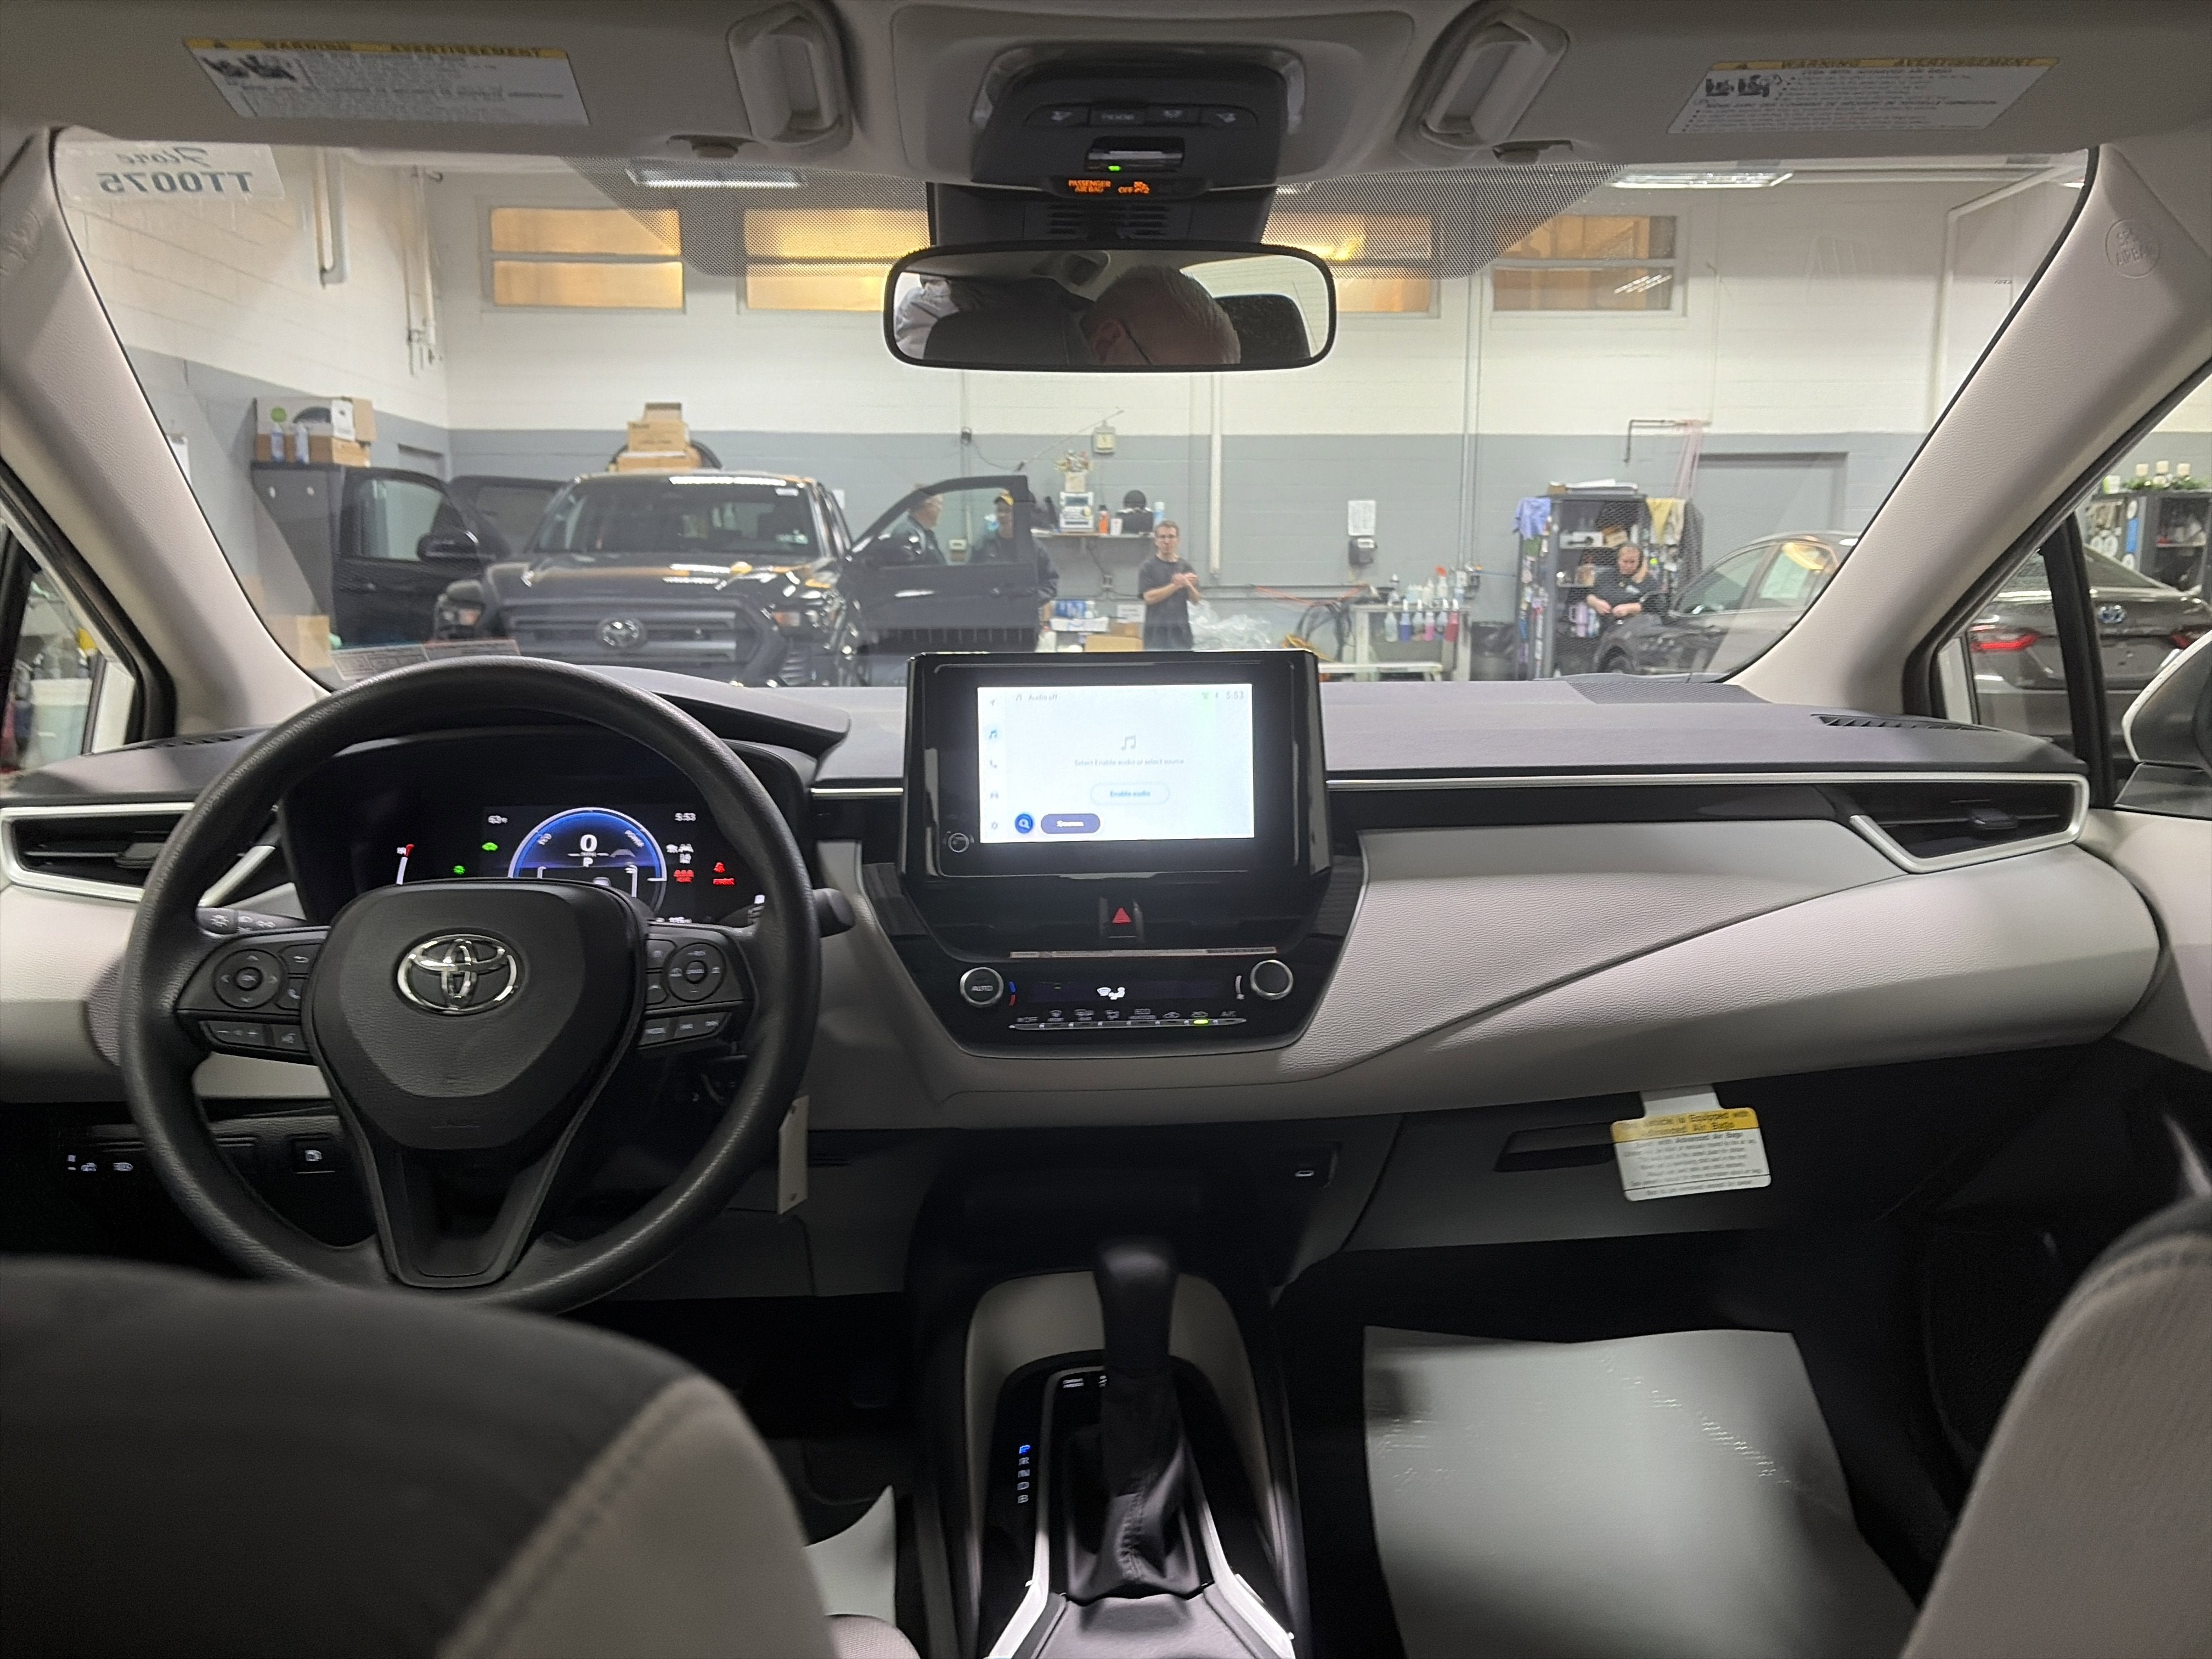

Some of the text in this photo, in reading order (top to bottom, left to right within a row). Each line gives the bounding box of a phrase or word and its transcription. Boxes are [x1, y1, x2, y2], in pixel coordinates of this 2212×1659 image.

[675, 812, 696, 821] 5:53
[580, 834, 597, 852] 0
[583, 857, 594, 868] P
[1019, 1444, 1031, 1454] P
[1018, 1457, 1030, 1466] R
[1017, 1481, 1030, 1491] D
[1018, 1494, 1029, 1504] B
